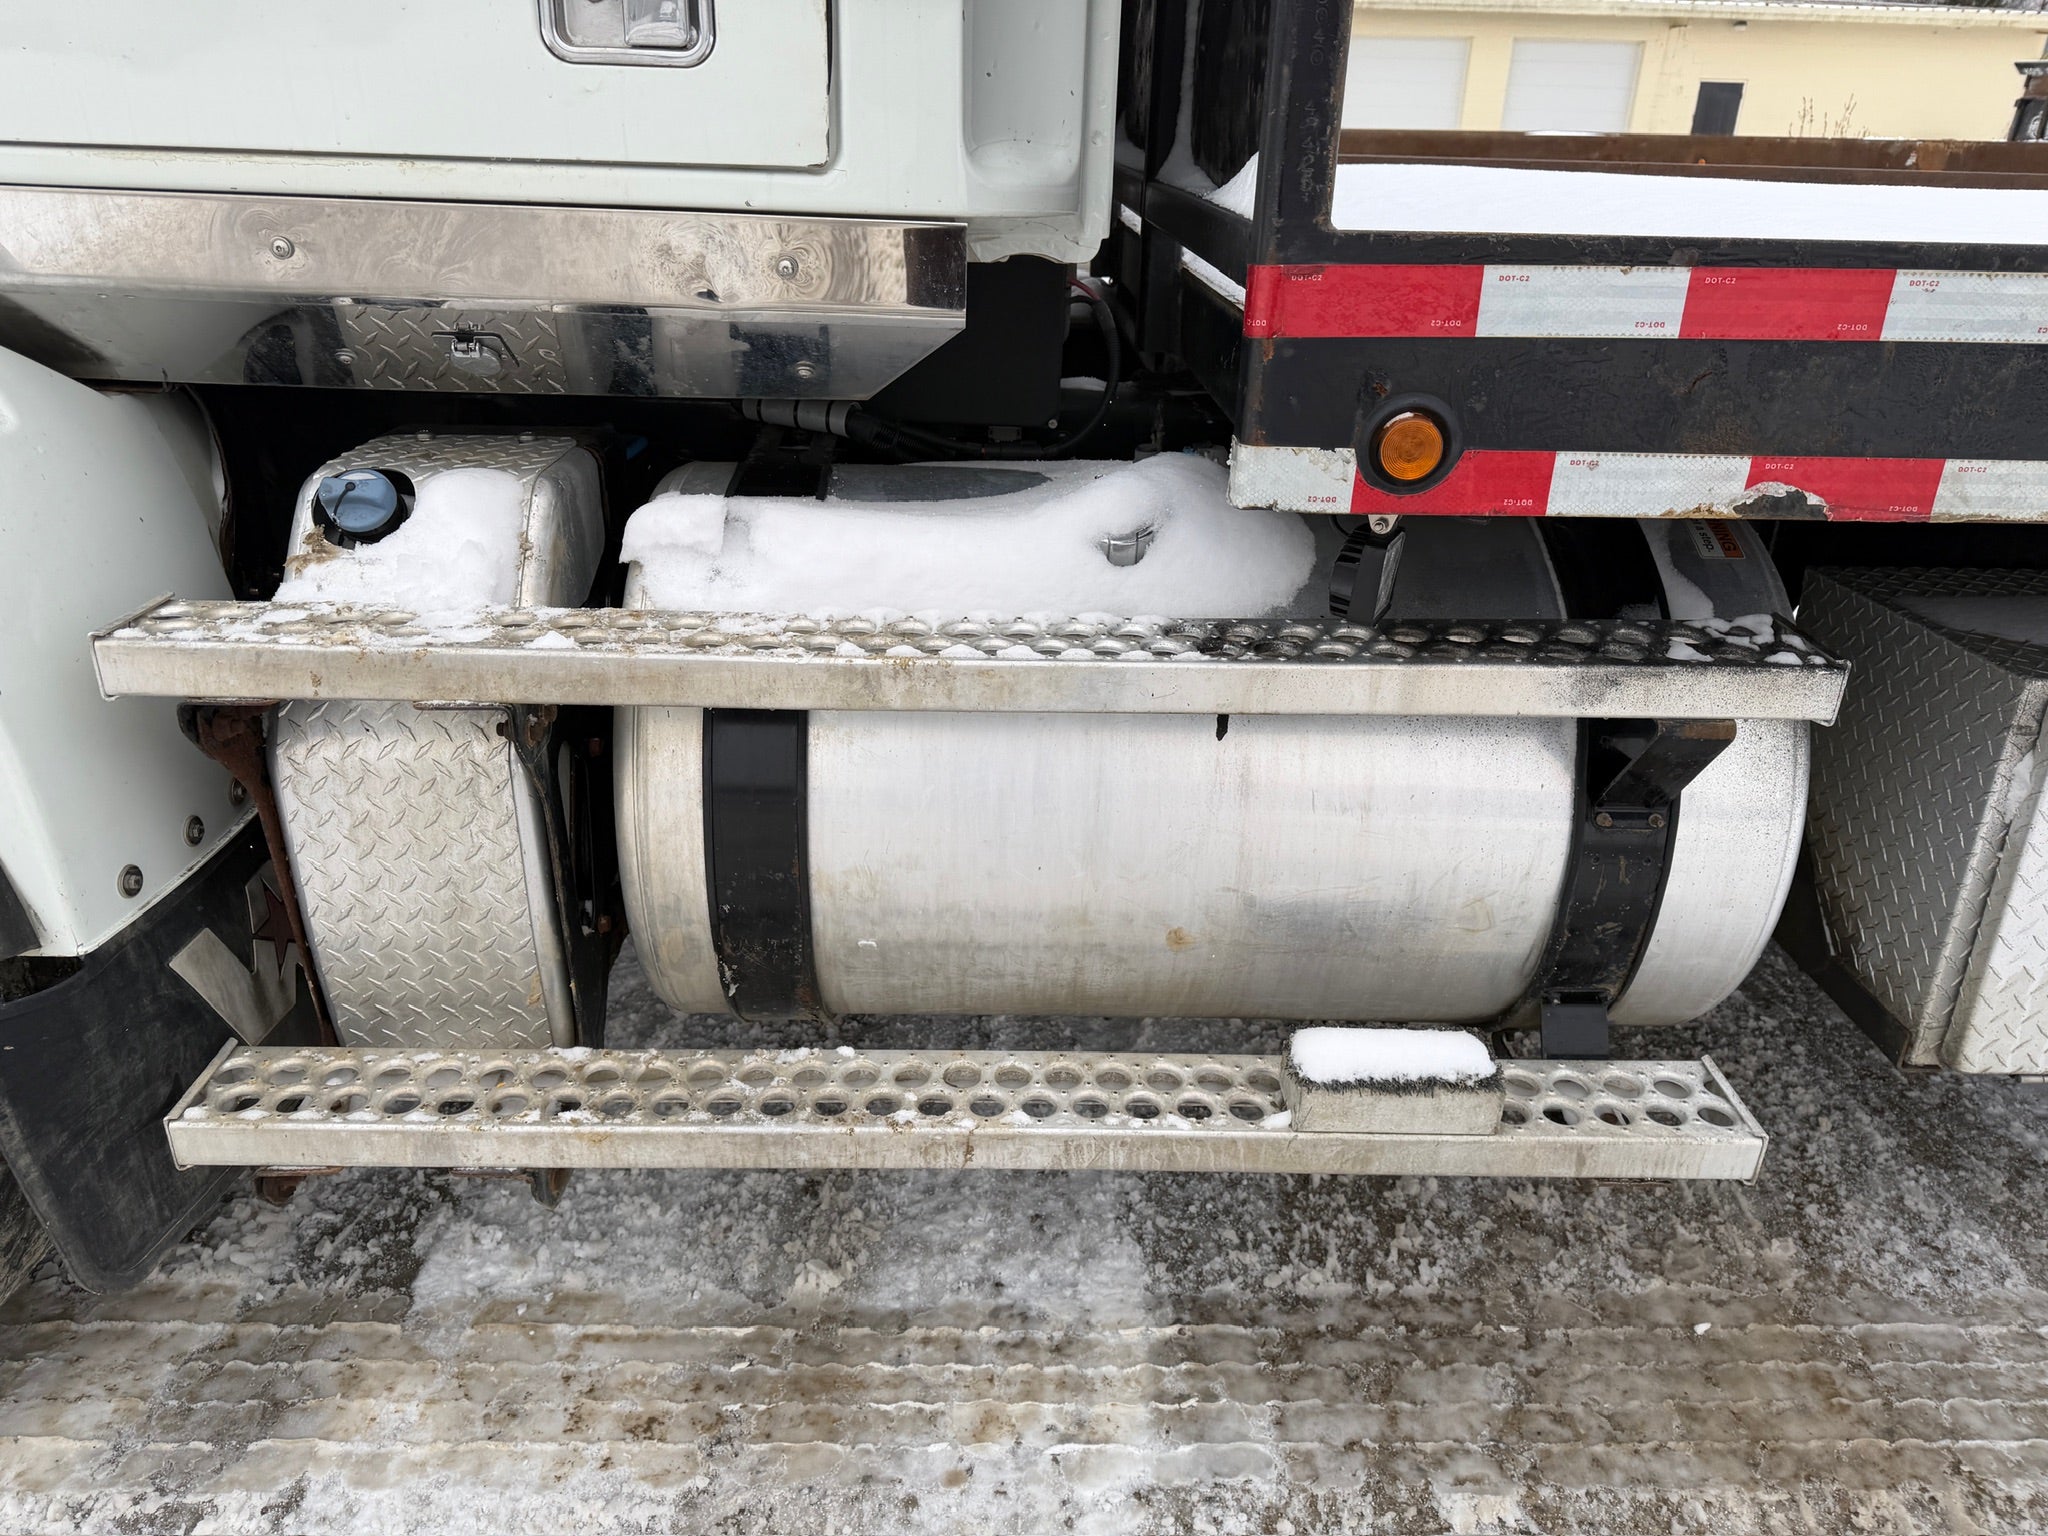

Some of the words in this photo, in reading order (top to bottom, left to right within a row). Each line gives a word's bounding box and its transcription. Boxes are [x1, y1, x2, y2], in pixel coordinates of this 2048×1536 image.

[1704, 277, 1736, 285] DOT-C2
[1430, 319, 1461, 327] DOT-C2
[1837, 323, 1868, 331] DOT-C2
[1308, 495, 1337, 503] DOT-C2
[1503, 498, 1533, 506] DOT-C2
[1707, 520, 1736, 552] NING
